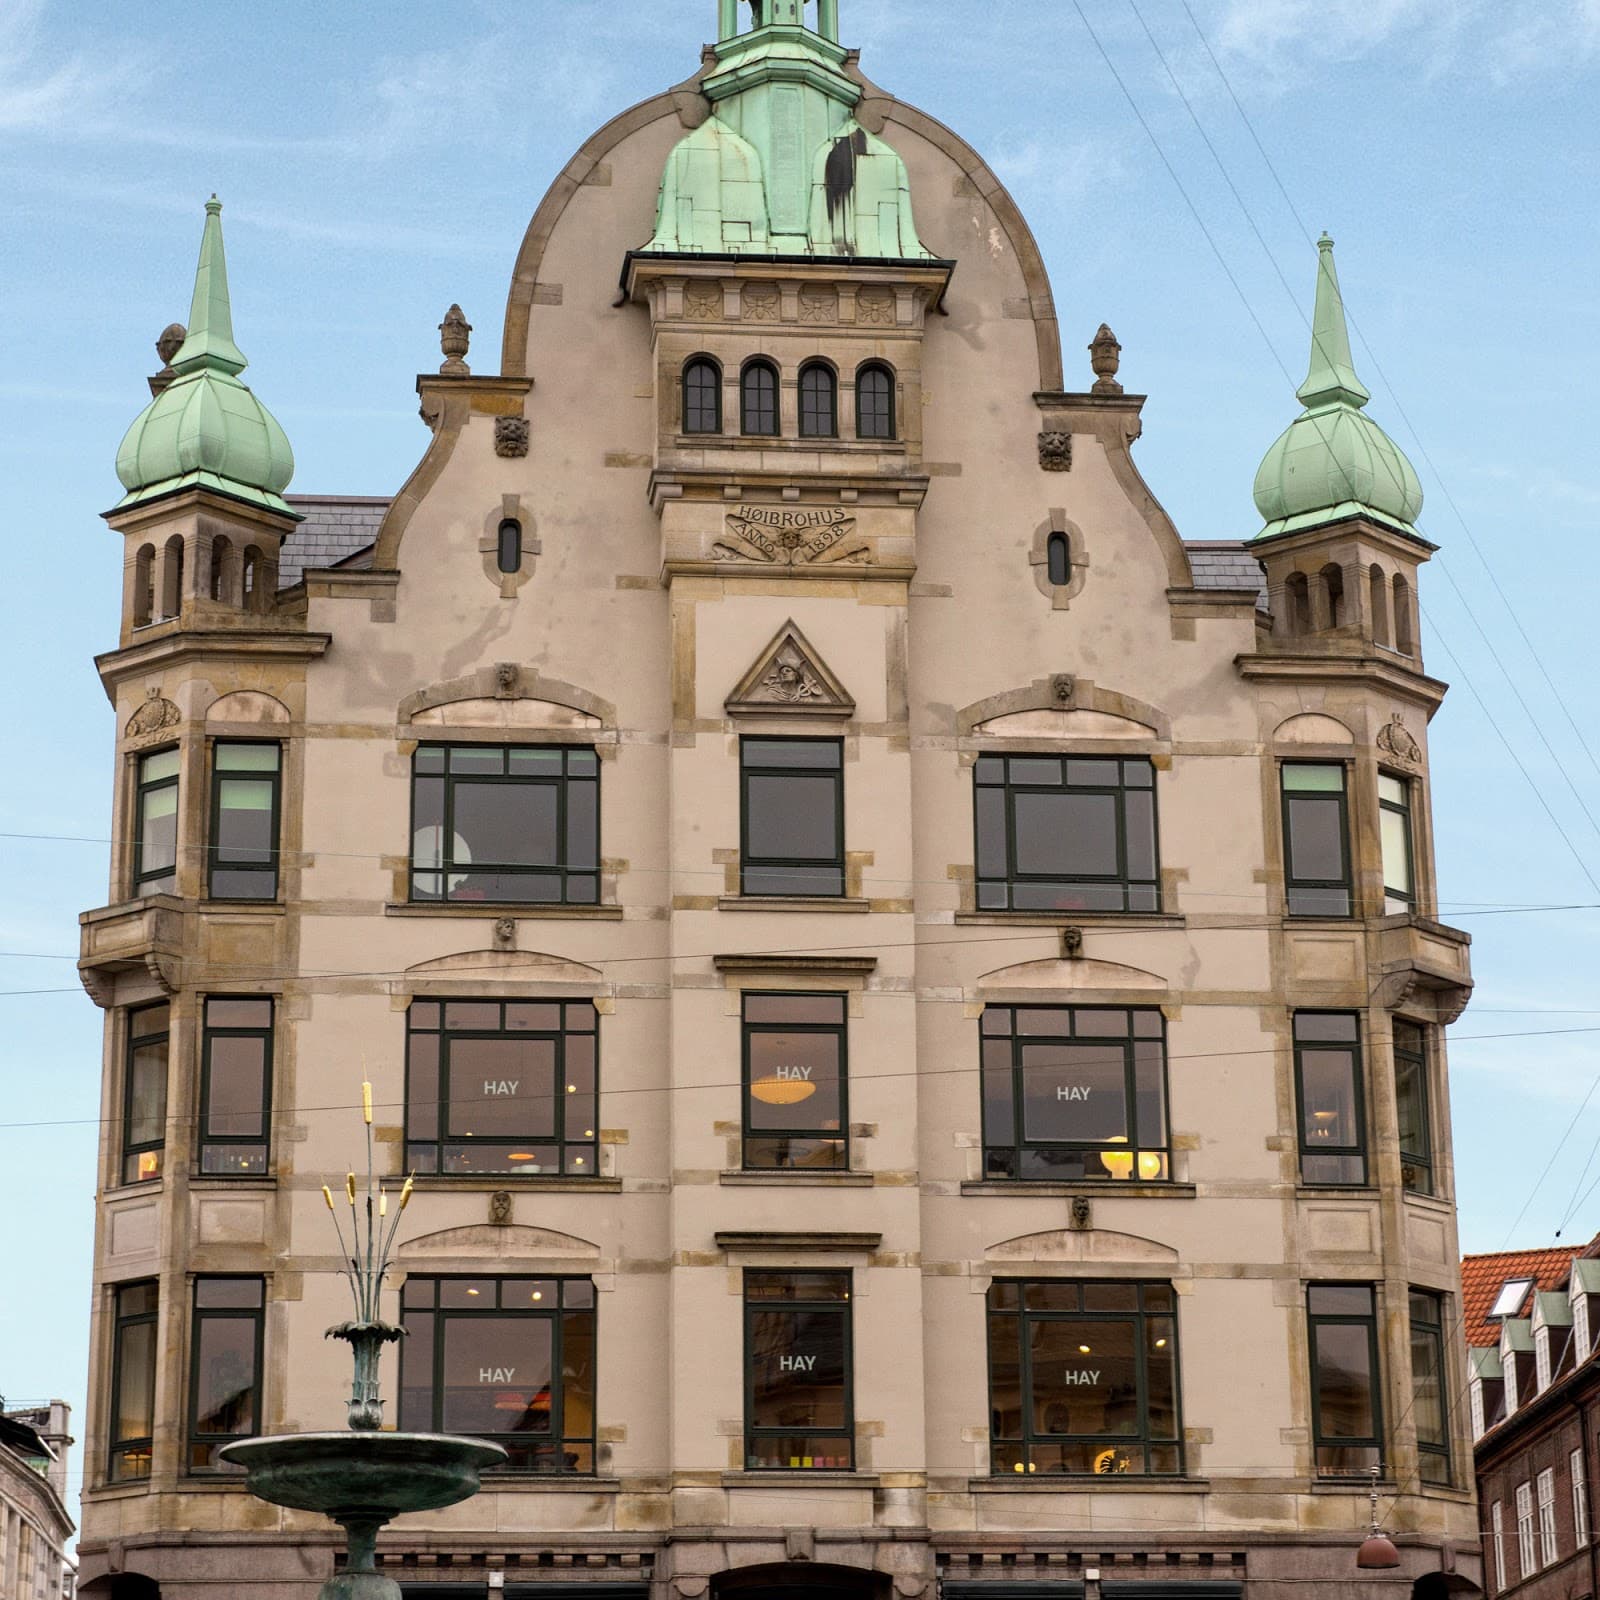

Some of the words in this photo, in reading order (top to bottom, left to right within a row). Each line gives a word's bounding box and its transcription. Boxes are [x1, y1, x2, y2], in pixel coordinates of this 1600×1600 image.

[739, 505, 846, 527] HØIBROHUS
[735, 522, 775, 554] ANNO
[807, 525, 844, 556] 1898
[776, 1066, 812, 1081] HAY
[483, 1080, 518, 1096] HAY
[1056, 1086, 1090, 1101] HAY
[779, 1355, 816, 1371] HAY
[478, 1367, 515, 1383] HAY
[1065, 1370, 1100, 1385] HAY
